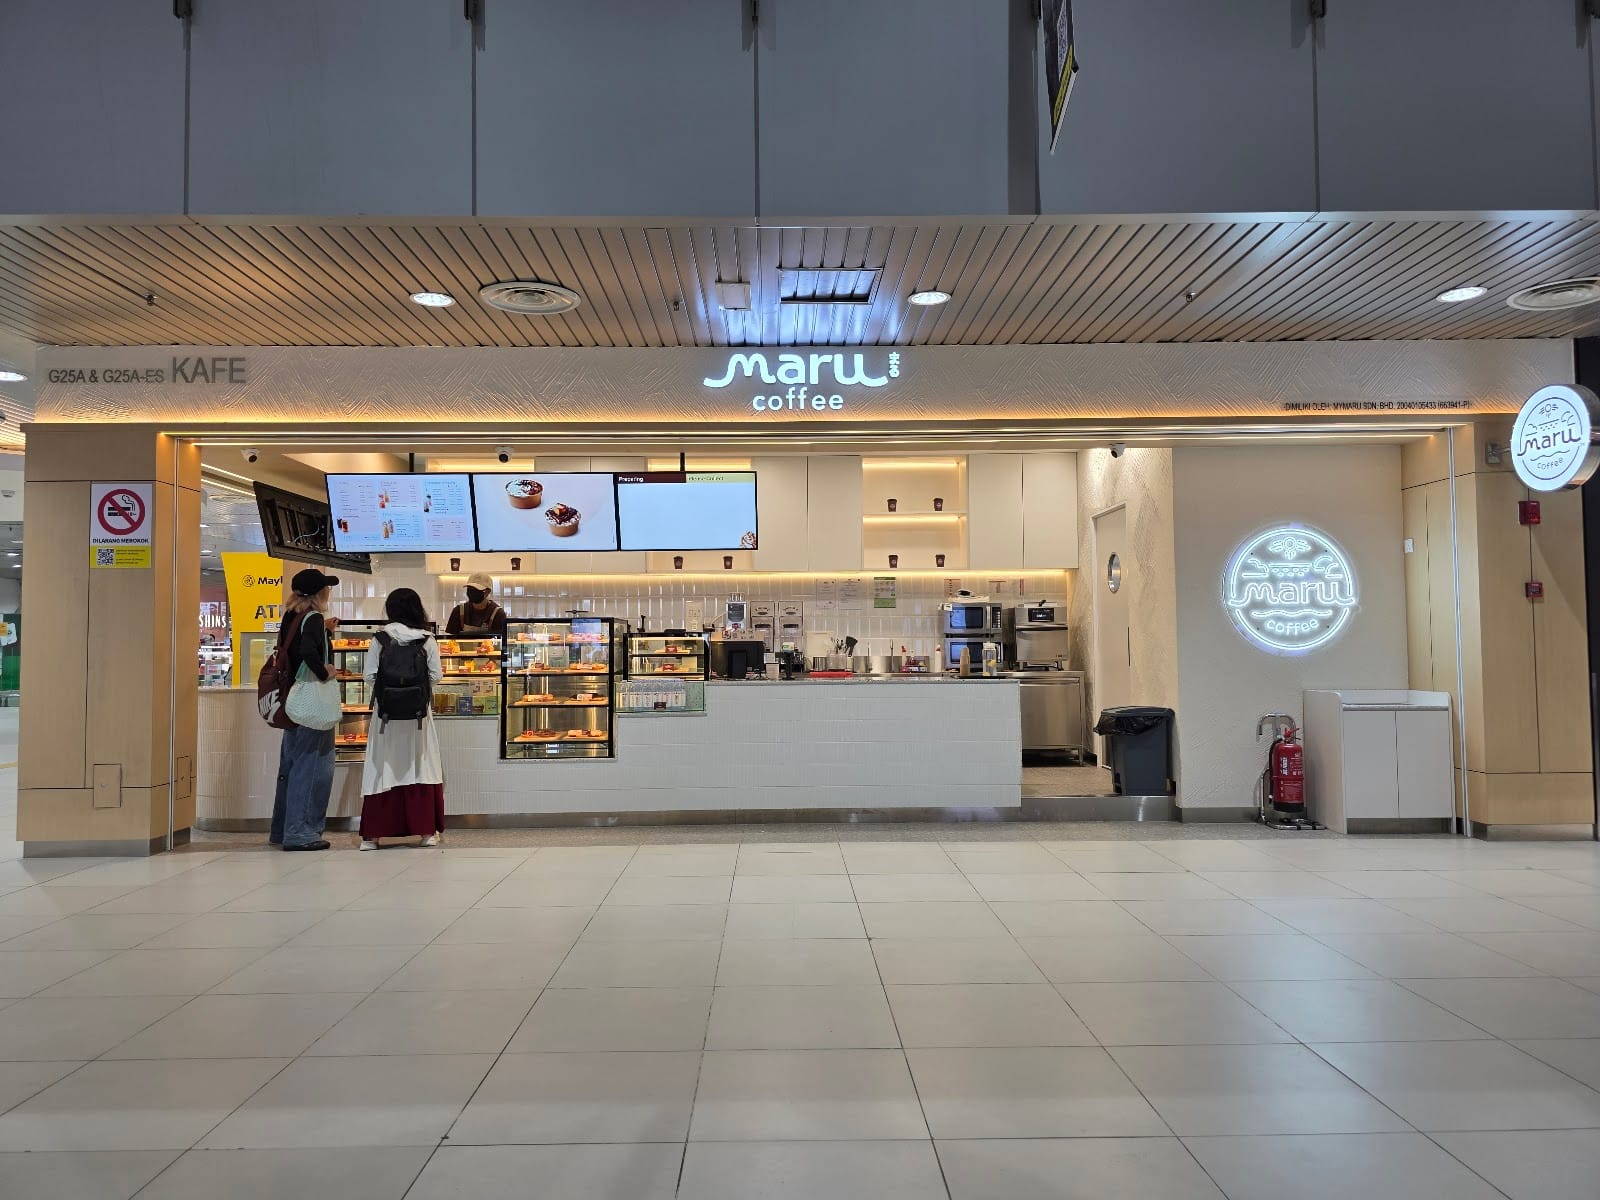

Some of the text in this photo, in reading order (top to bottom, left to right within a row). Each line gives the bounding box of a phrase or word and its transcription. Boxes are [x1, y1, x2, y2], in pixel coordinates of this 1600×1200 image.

[49, 369, 86, 383] G25A
[89, 369, 98, 383] &
[171, 357, 247, 384] KAFE
[703, 353, 888, 388] maru
[752, 387, 844, 411] coffee
[1517, 428, 1581, 457] maru
[1228, 581, 1356, 607] maru
[1265, 619, 1319, 636] coffee
